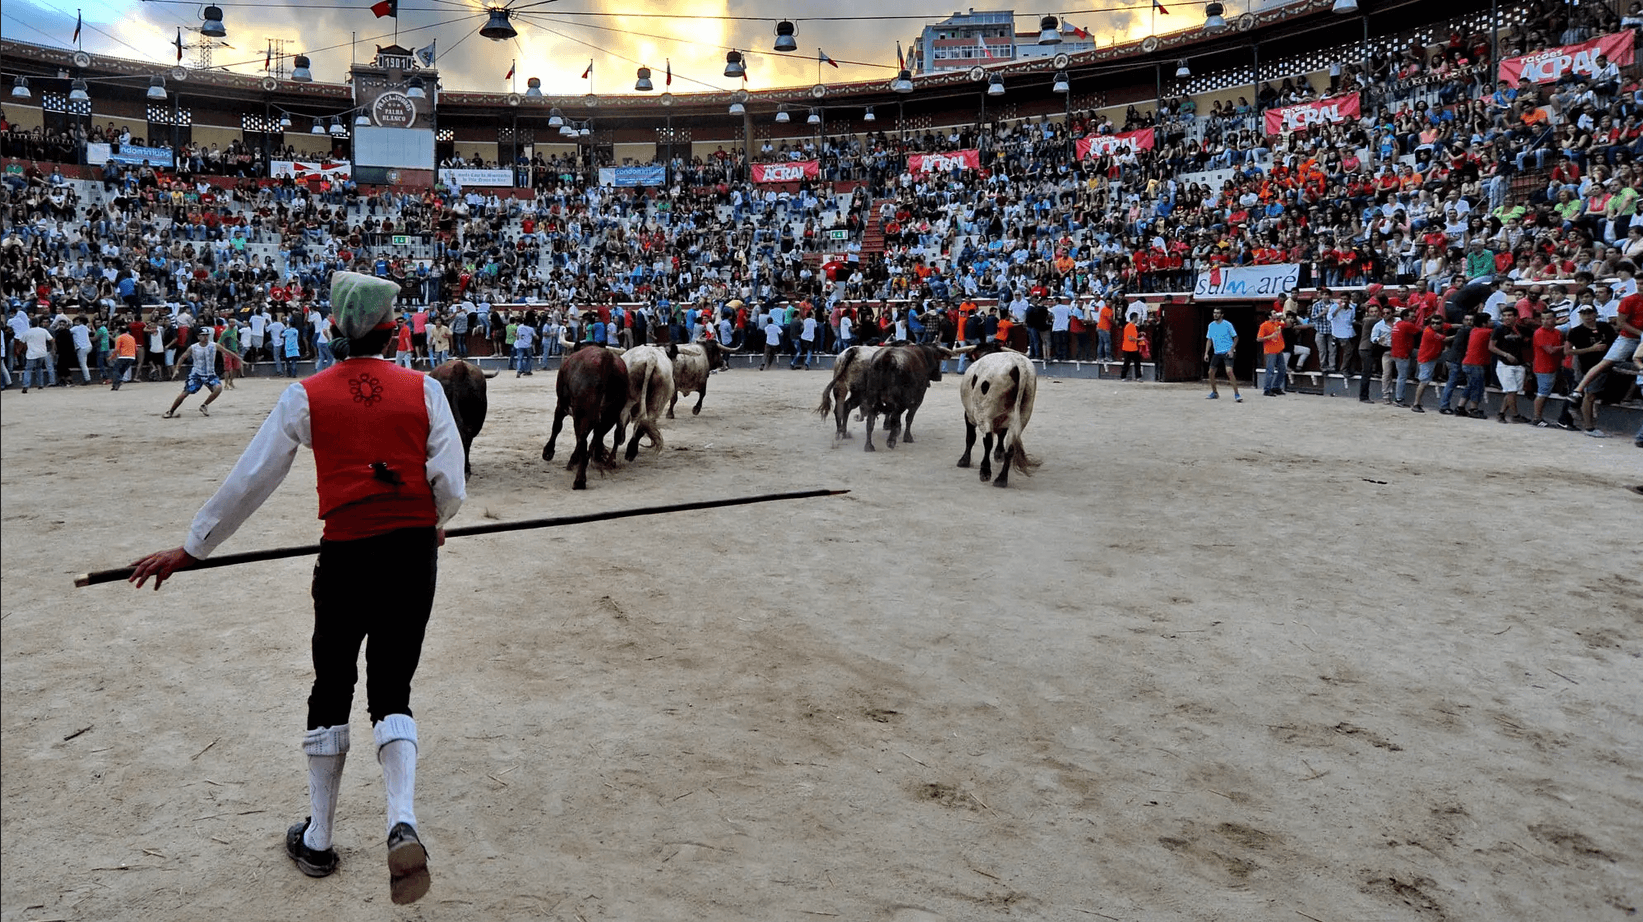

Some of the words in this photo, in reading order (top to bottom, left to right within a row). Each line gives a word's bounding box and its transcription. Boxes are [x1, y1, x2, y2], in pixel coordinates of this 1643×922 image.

[385, 57, 406, 68] 1901
[1520, 49, 1563, 64] rações
[1280, 104, 1312, 115] rações
[1280, 103, 1344, 131] ACRAL
[920, 155, 968, 173] ACRAL
